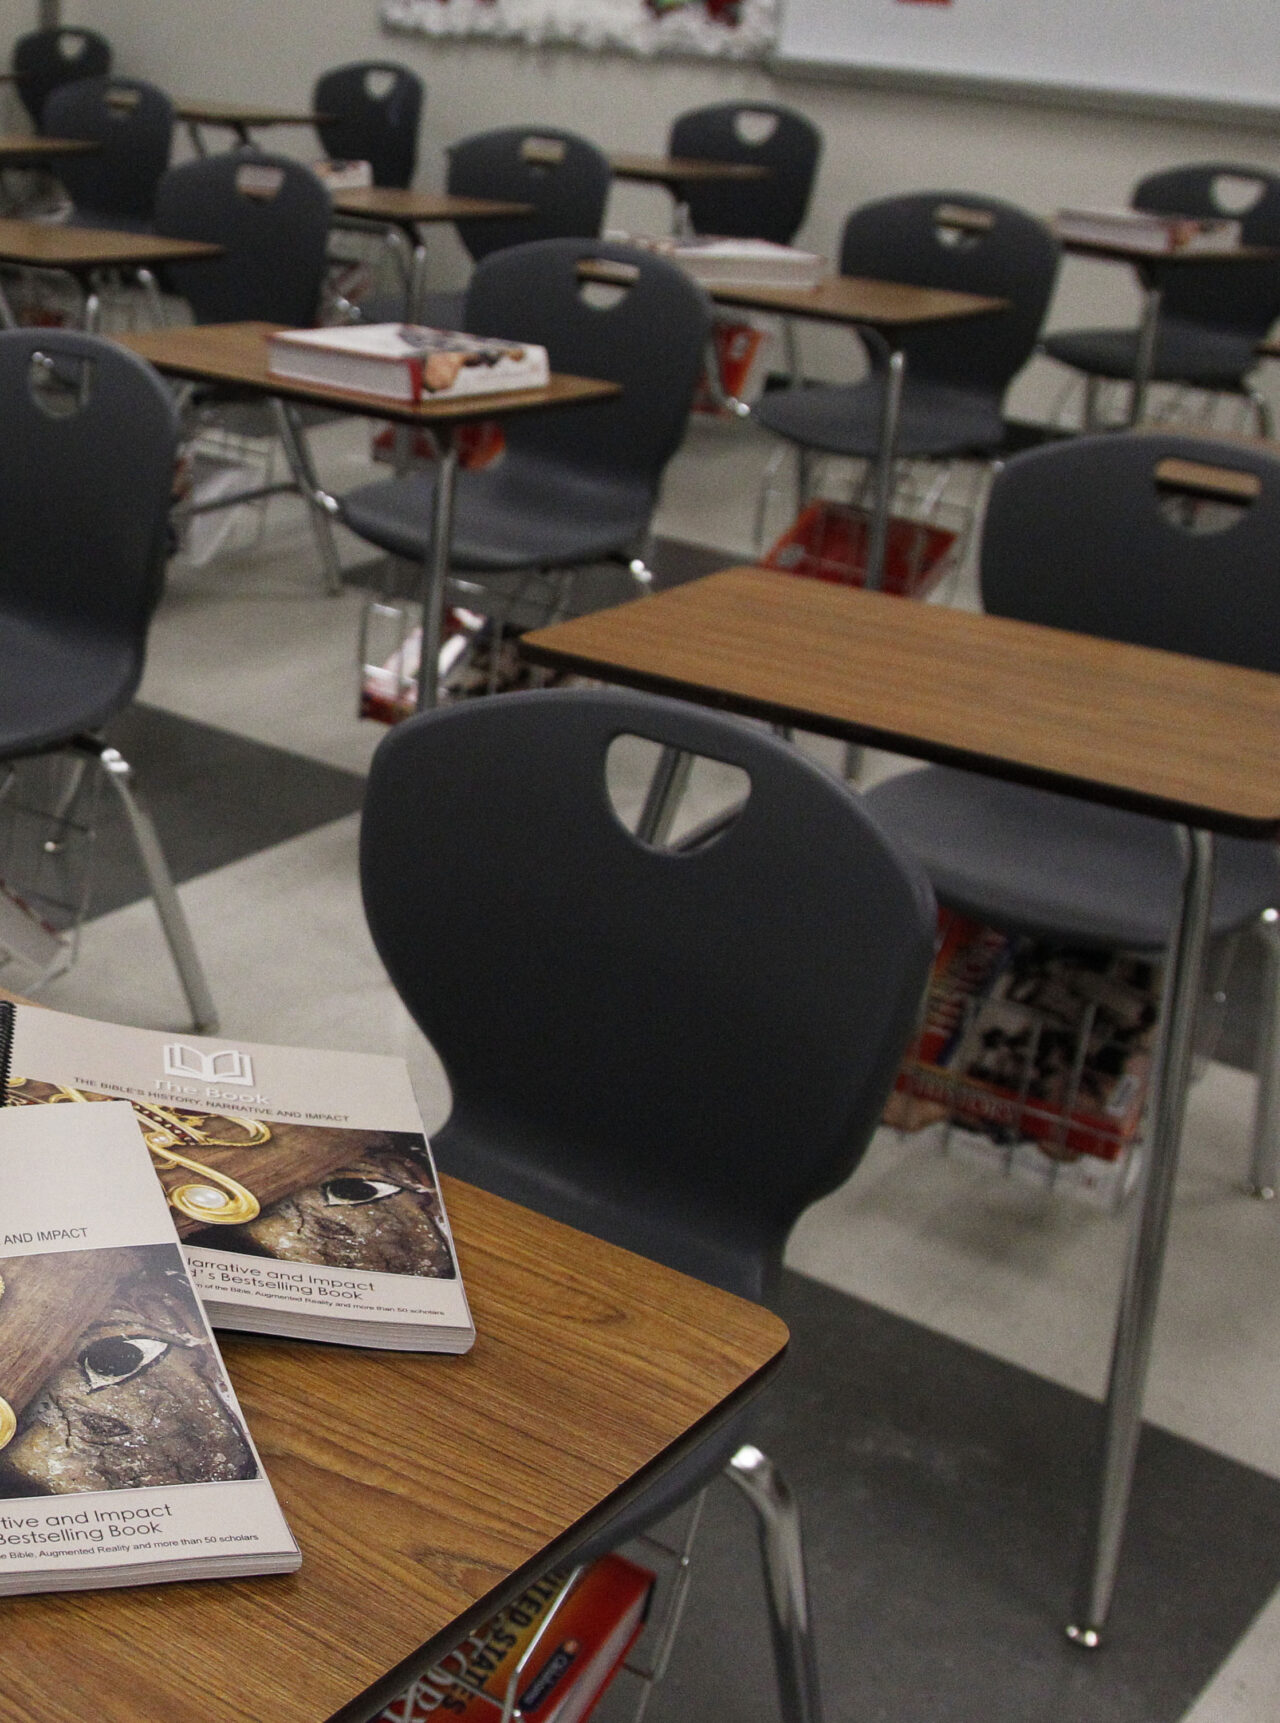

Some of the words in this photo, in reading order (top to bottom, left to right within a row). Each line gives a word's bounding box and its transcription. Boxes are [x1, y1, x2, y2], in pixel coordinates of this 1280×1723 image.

[73, 1077, 96, 1087] THE
[100, 1082, 145, 1096] BIBLE'S
[148, 1091, 203, 1105] HISTORY,
[206, 1100, 273, 1115] NARRATIVE
[276, 1109, 302, 1118] AND
[305, 1112, 350, 1122] IMPACT
[152, 1079, 197, 1095] The
[205, 1087, 270, 1104] Book
[4, 1232, 34, 1245] AND
[36, 1227, 89, 1242] IMPACT
[221, 1272, 313, 1295] Bestselling
[319, 1287, 364, 1300] Book
[267, 1269, 304, 1283] and
[309, 1276, 376, 1292] Impact
[215, 1284, 229, 1292] the
[255, 1290, 303, 1303] Augmented
[305, 1297, 334, 1308] Reality
[335, 1301, 352, 1309] and
[353, 1304, 375, 1312] more
[410, 1308, 446, 1316] scholars
[45, 1511, 89, 1526] and
[94, 1504, 173, 1522] Impact
[108, 1521, 163, 1538] Book
[9, 1550, 37, 1560] Bible,
[39, 1547, 96, 1558] Augmented
[97, 1544, 131, 1555] Reality
[133, 1542, 152, 1550] and
[154, 1540, 179, 1548] more
[180, 1536, 202, 1545] than
[204, 1535, 217, 1543] 50
[219, 1533, 260, 1543] scholars
